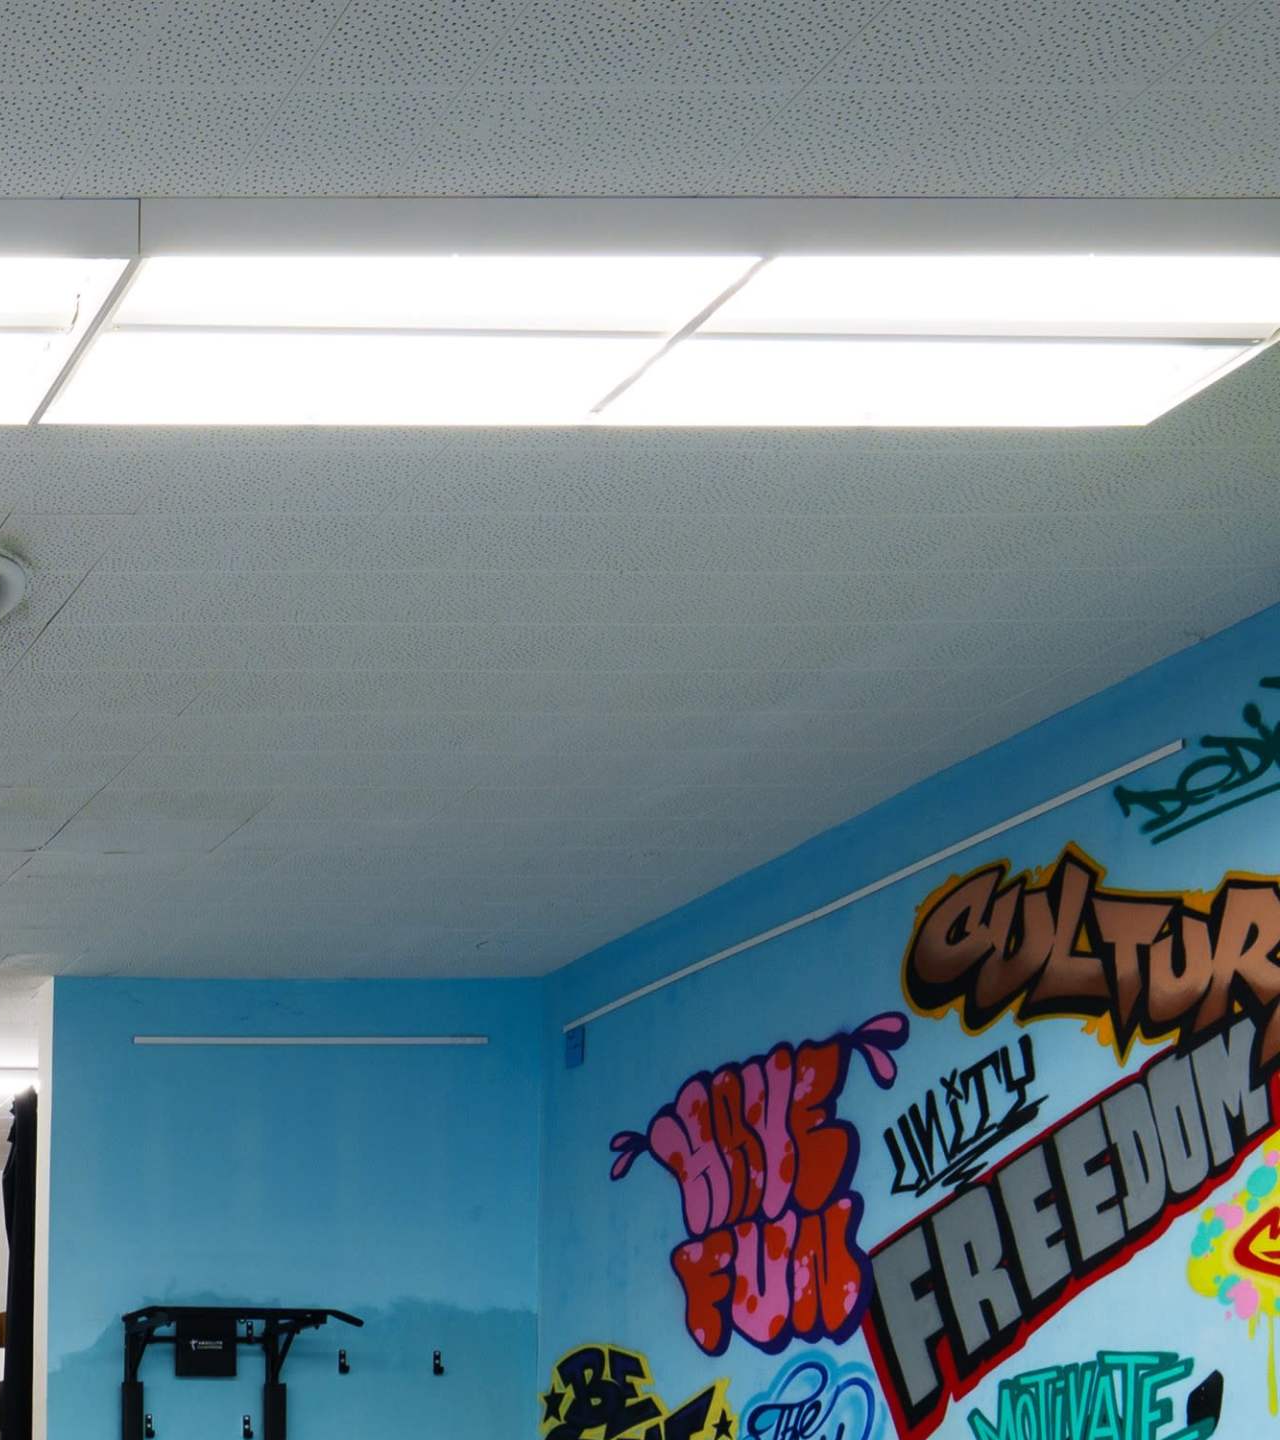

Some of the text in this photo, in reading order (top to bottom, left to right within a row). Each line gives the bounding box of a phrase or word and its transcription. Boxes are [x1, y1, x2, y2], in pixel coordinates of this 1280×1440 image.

[902, 841, 1280, 1067] CULTUR
[647, 1036, 860, 1234] HAVE
[868, 1017, 1274, 1420] FREEDOM
[670, 1190, 870, 1357] FUN
[555, 1347, 658, 1437] BE
